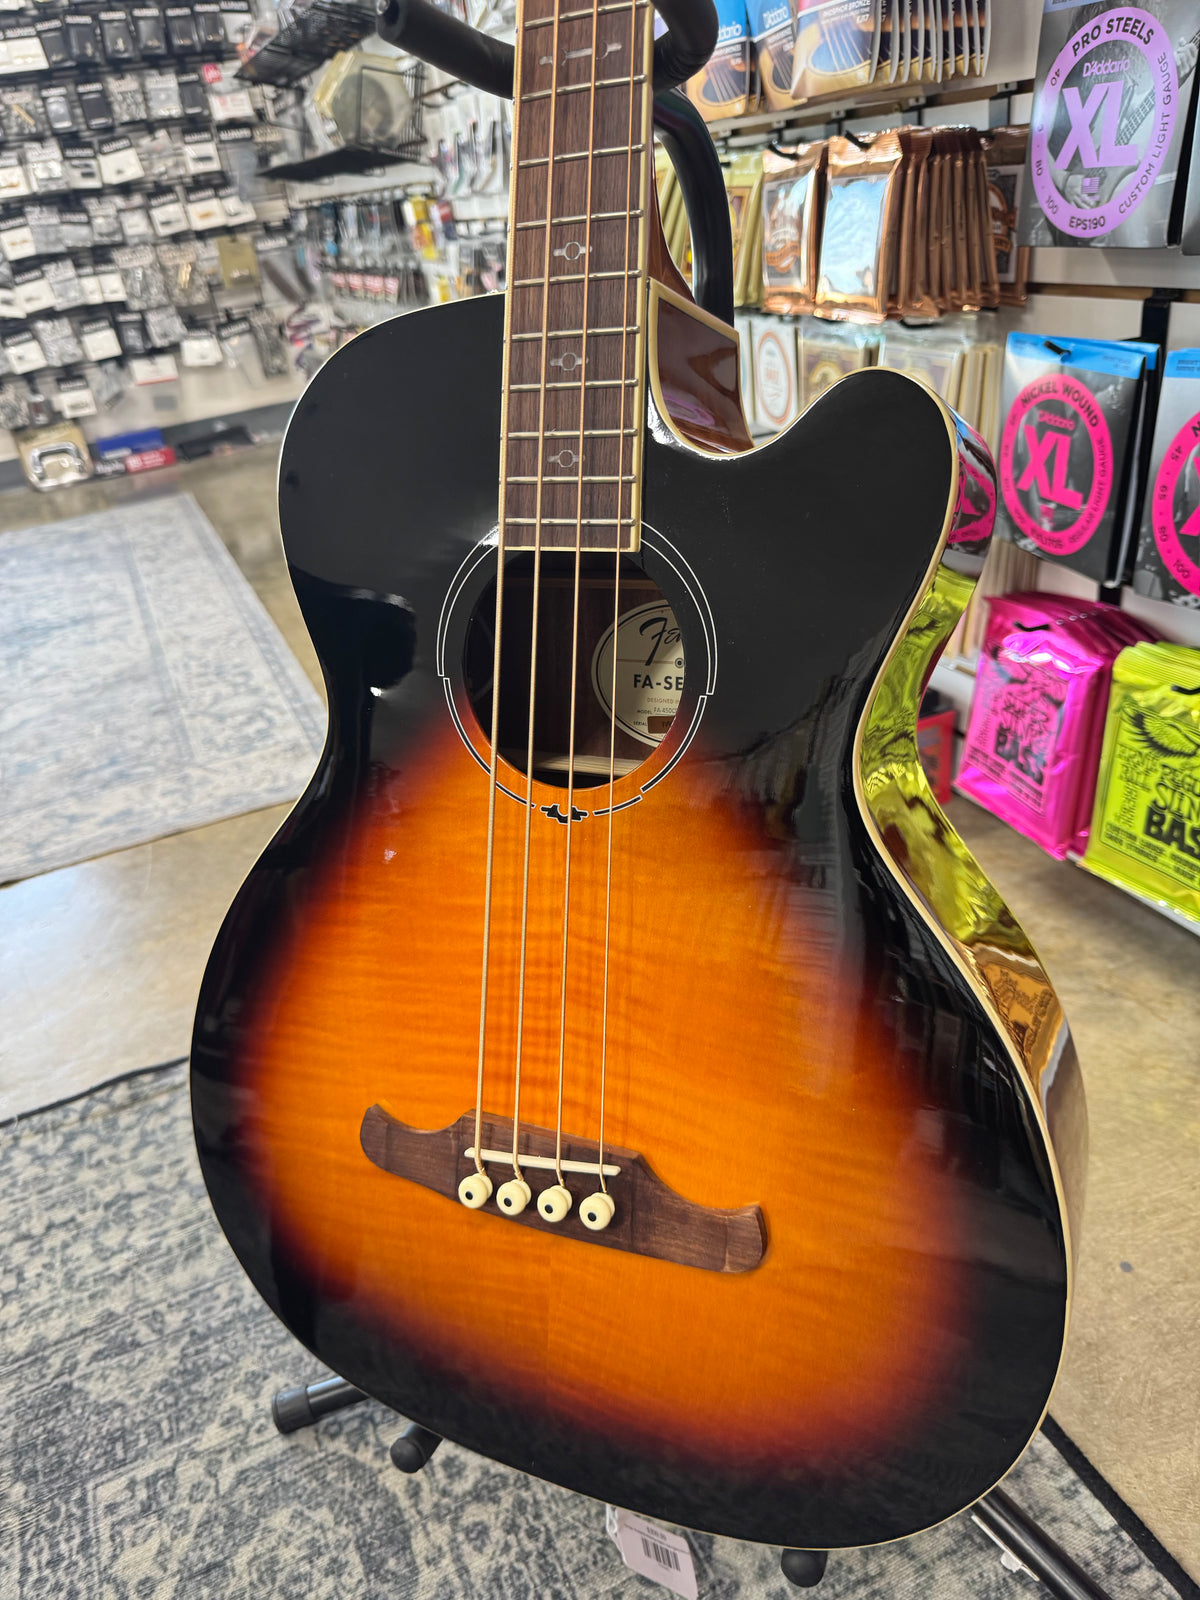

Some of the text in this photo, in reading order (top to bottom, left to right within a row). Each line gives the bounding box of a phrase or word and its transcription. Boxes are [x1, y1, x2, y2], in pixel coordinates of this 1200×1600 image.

[1071, 16, 1154, 57] PRO STEELS
[1082, 57, 1131, 78] D'Addario
[1054, 80, 1139, 170] XL
[1118, 52, 1173, 214] CUSTOM LIGHT GAUGE
[1068, 215, 1106, 231] EPS190
[1020, 381, 1100, 428] NICKEL WOUND
[1016, 424, 1084, 511] XL
[633, 674, 684, 691] FA-SE
[646, 697, 674, 705] DESIGNED
